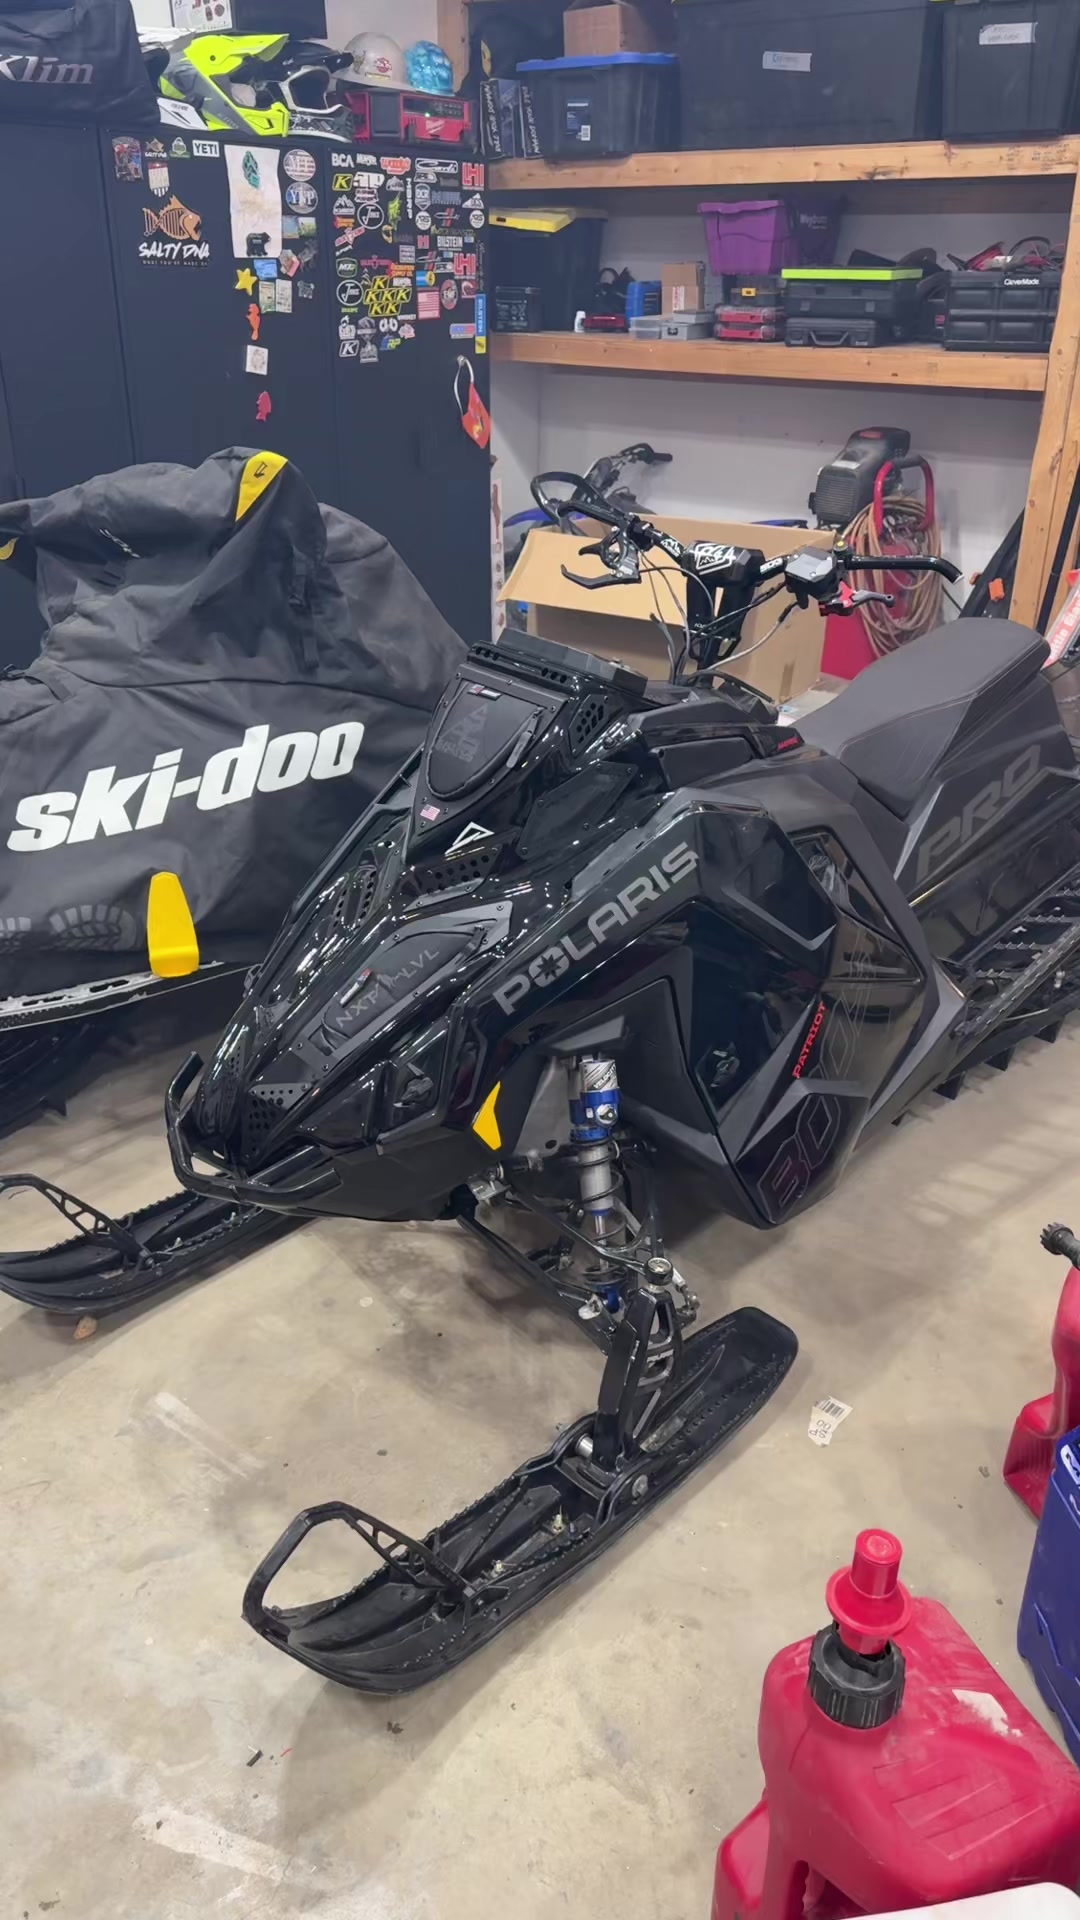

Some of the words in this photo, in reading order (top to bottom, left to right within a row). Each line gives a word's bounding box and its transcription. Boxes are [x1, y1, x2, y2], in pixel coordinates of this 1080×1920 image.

[0, 54, 94, 84] Klim
[194, 142, 218, 155] YETI
[331, 153, 355, 168] BCA
[334, 176, 351, 189] K
[138, 240, 181, 258] SALTY
[182, 242, 210, 257] DNA
[437, 236, 463, 248] BILSTEIN
[7, 721, 365, 852] ski-doo
[916, 744, 1041, 884] PRO
[493, 841, 699, 1016] POLARIS
[791, 1001, 829, 1080] PATRIOT
